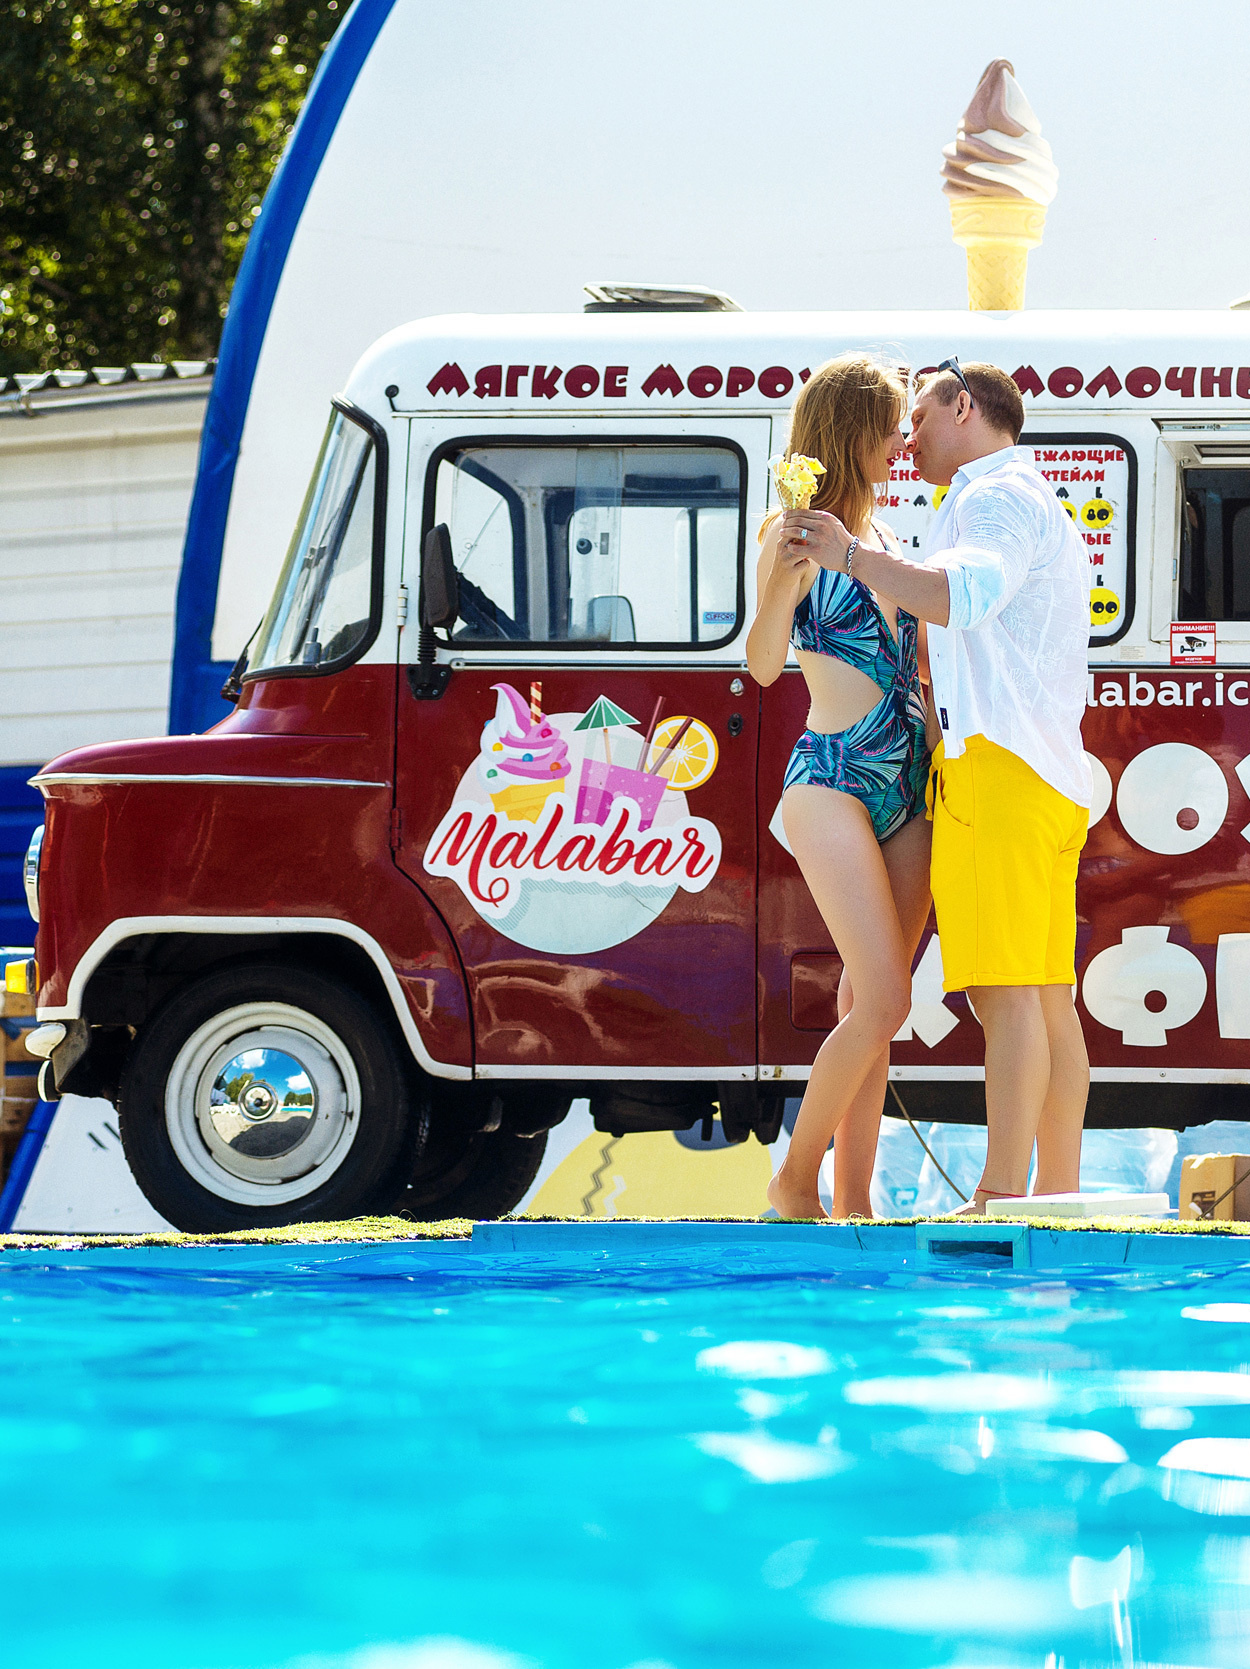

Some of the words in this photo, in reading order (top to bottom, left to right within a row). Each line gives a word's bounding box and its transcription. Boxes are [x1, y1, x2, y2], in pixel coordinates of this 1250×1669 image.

[426, 362, 629, 400] МЯГКОЕ
[641, 363, 812, 400] МОРО
[1034, 450, 1124, 464] ЕЖАЮЩИЕ
[1041, 467, 1105, 482] КТЕЙЛИ
[1090, 601, 1117, 613] 00
[428, 803, 715, 908] Malabar
